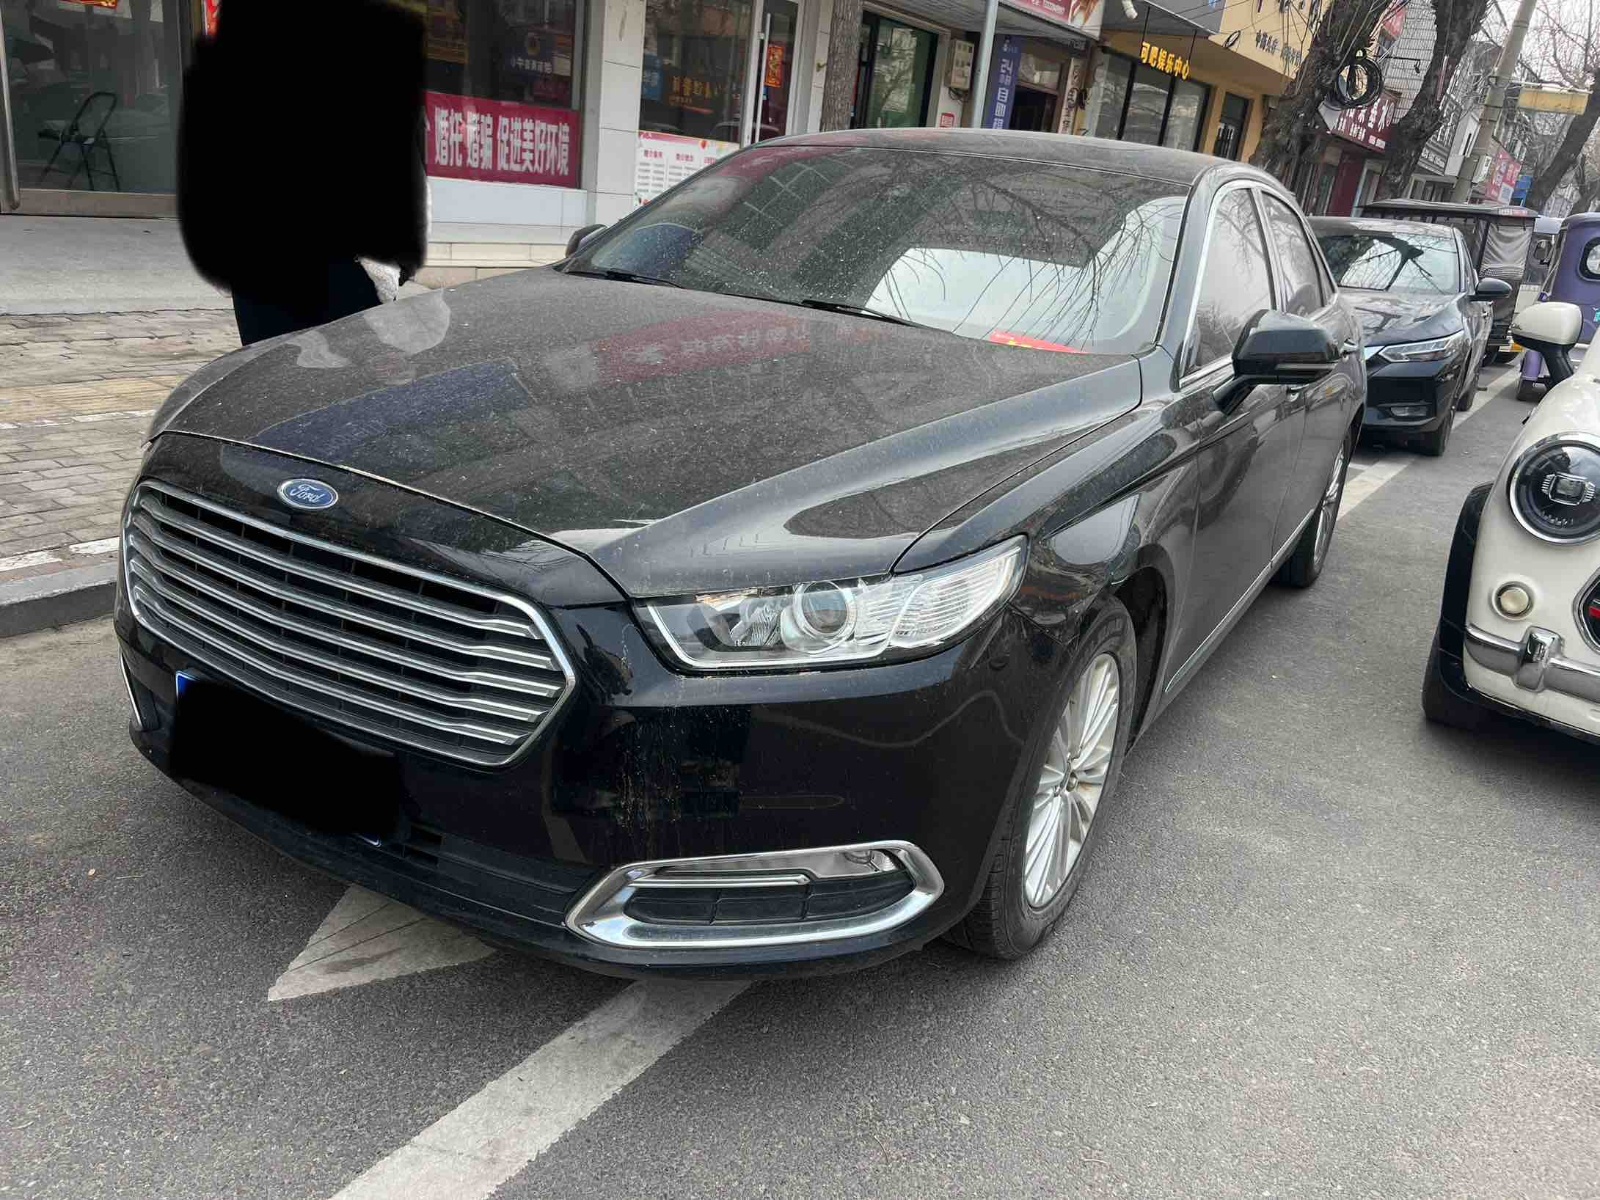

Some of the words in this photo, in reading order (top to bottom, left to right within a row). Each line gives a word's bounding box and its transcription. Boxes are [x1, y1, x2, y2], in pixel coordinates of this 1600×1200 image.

[498, 116, 570, 176] 促进美好环境
[290, 483, 326, 503] Ford
